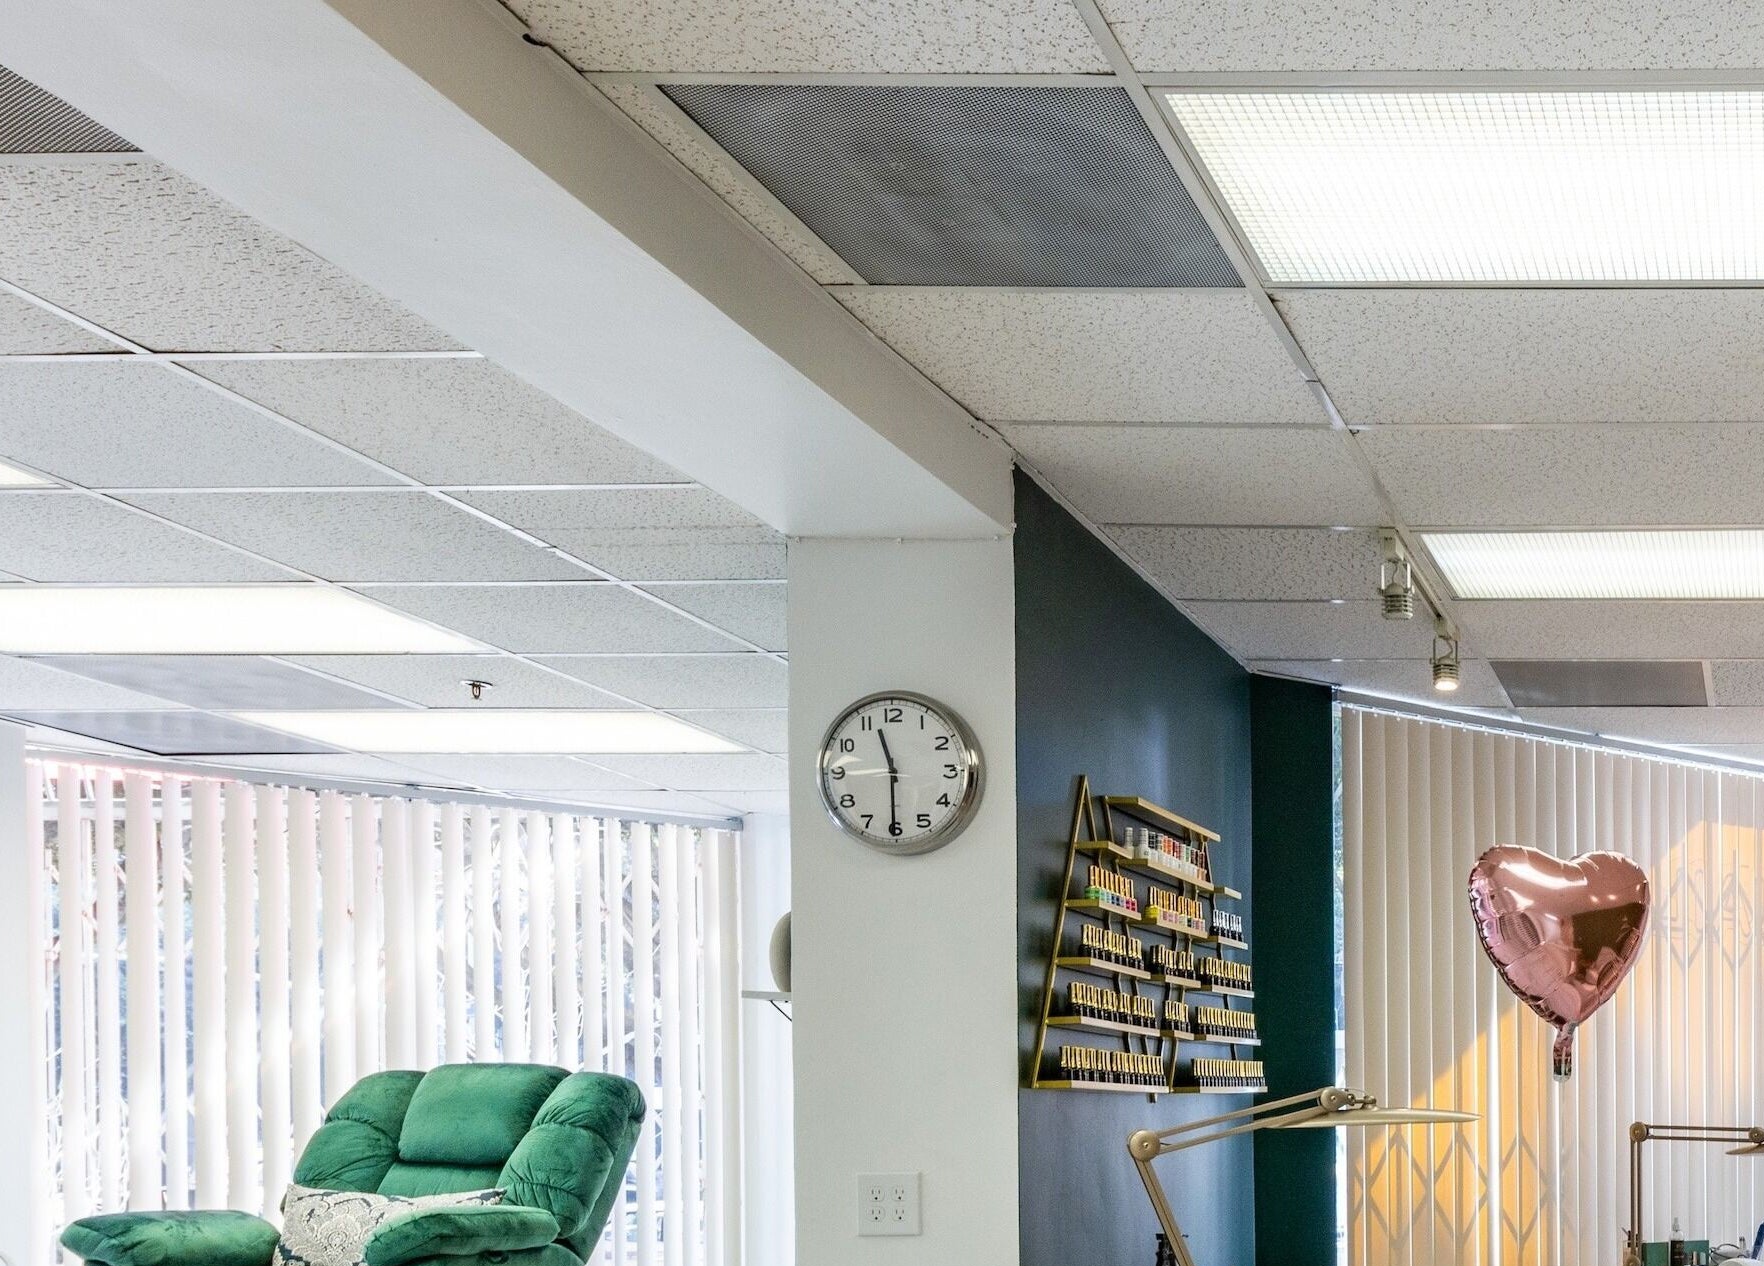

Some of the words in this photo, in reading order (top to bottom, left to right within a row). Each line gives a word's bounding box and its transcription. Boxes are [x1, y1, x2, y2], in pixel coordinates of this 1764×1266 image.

[884, 708, 903, 723] 12
[920, 715, 924, 730] 1
[862, 716, 872, 731] 11
[840, 738, 855, 753] 10
[935, 736, 949, 750] 2
[831, 766, 846, 780] 9
[943, 764, 958, 779] 3
[840, 794, 855, 808] 8
[936, 793, 950, 807] 4
[860, 814, 874, 829] 7
[916, 814, 931, 828] 5
[888, 822, 903, 836] 6
